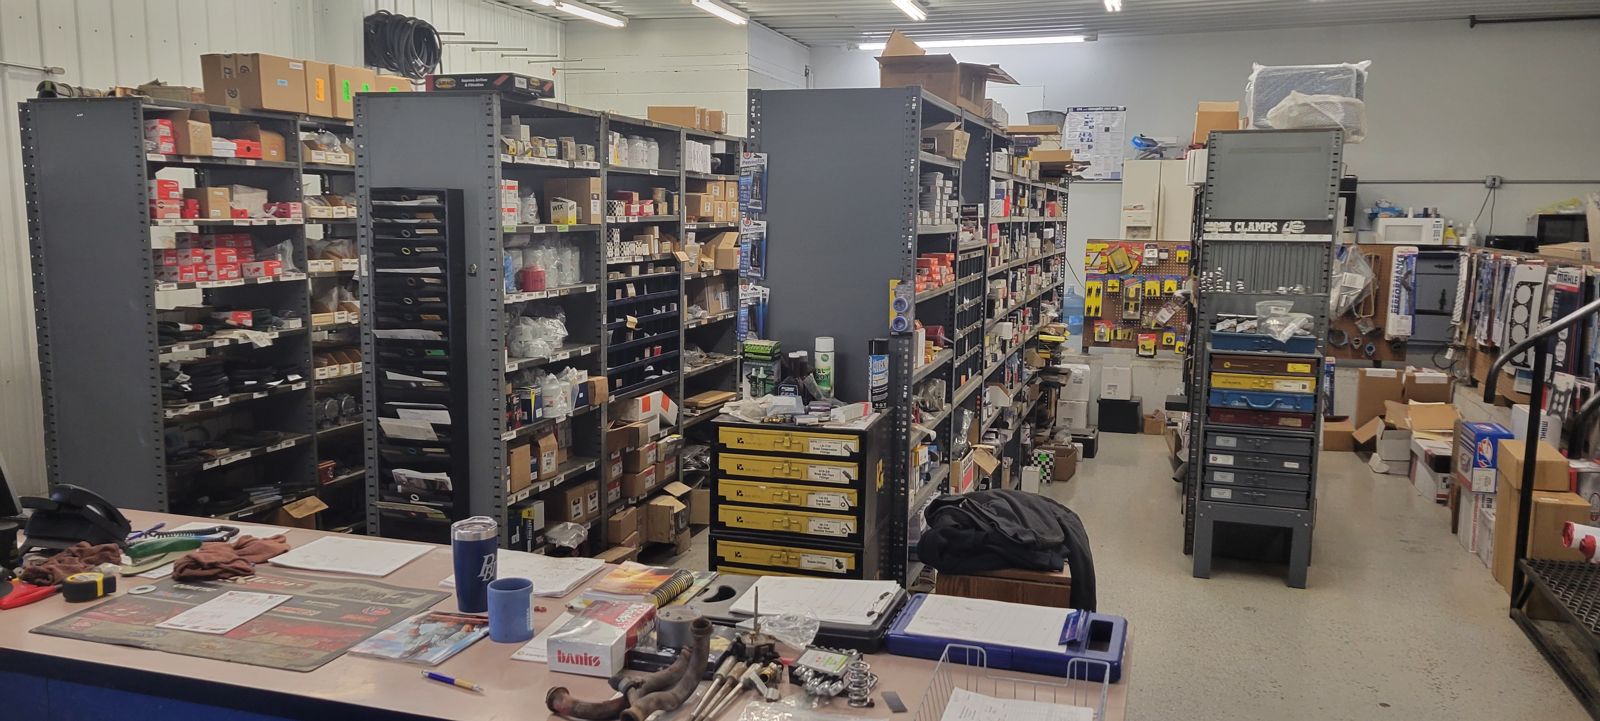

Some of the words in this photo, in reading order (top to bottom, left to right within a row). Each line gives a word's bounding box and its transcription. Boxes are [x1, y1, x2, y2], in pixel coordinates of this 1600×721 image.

[552, 203, 563, 212] WIX
[1234, 221, 1278, 233] CLAMPS
[1557, 273, 1579, 285] MAHLE
[1540, 420, 1549, 440] MAHL
[557, 649, 601, 667] banks
